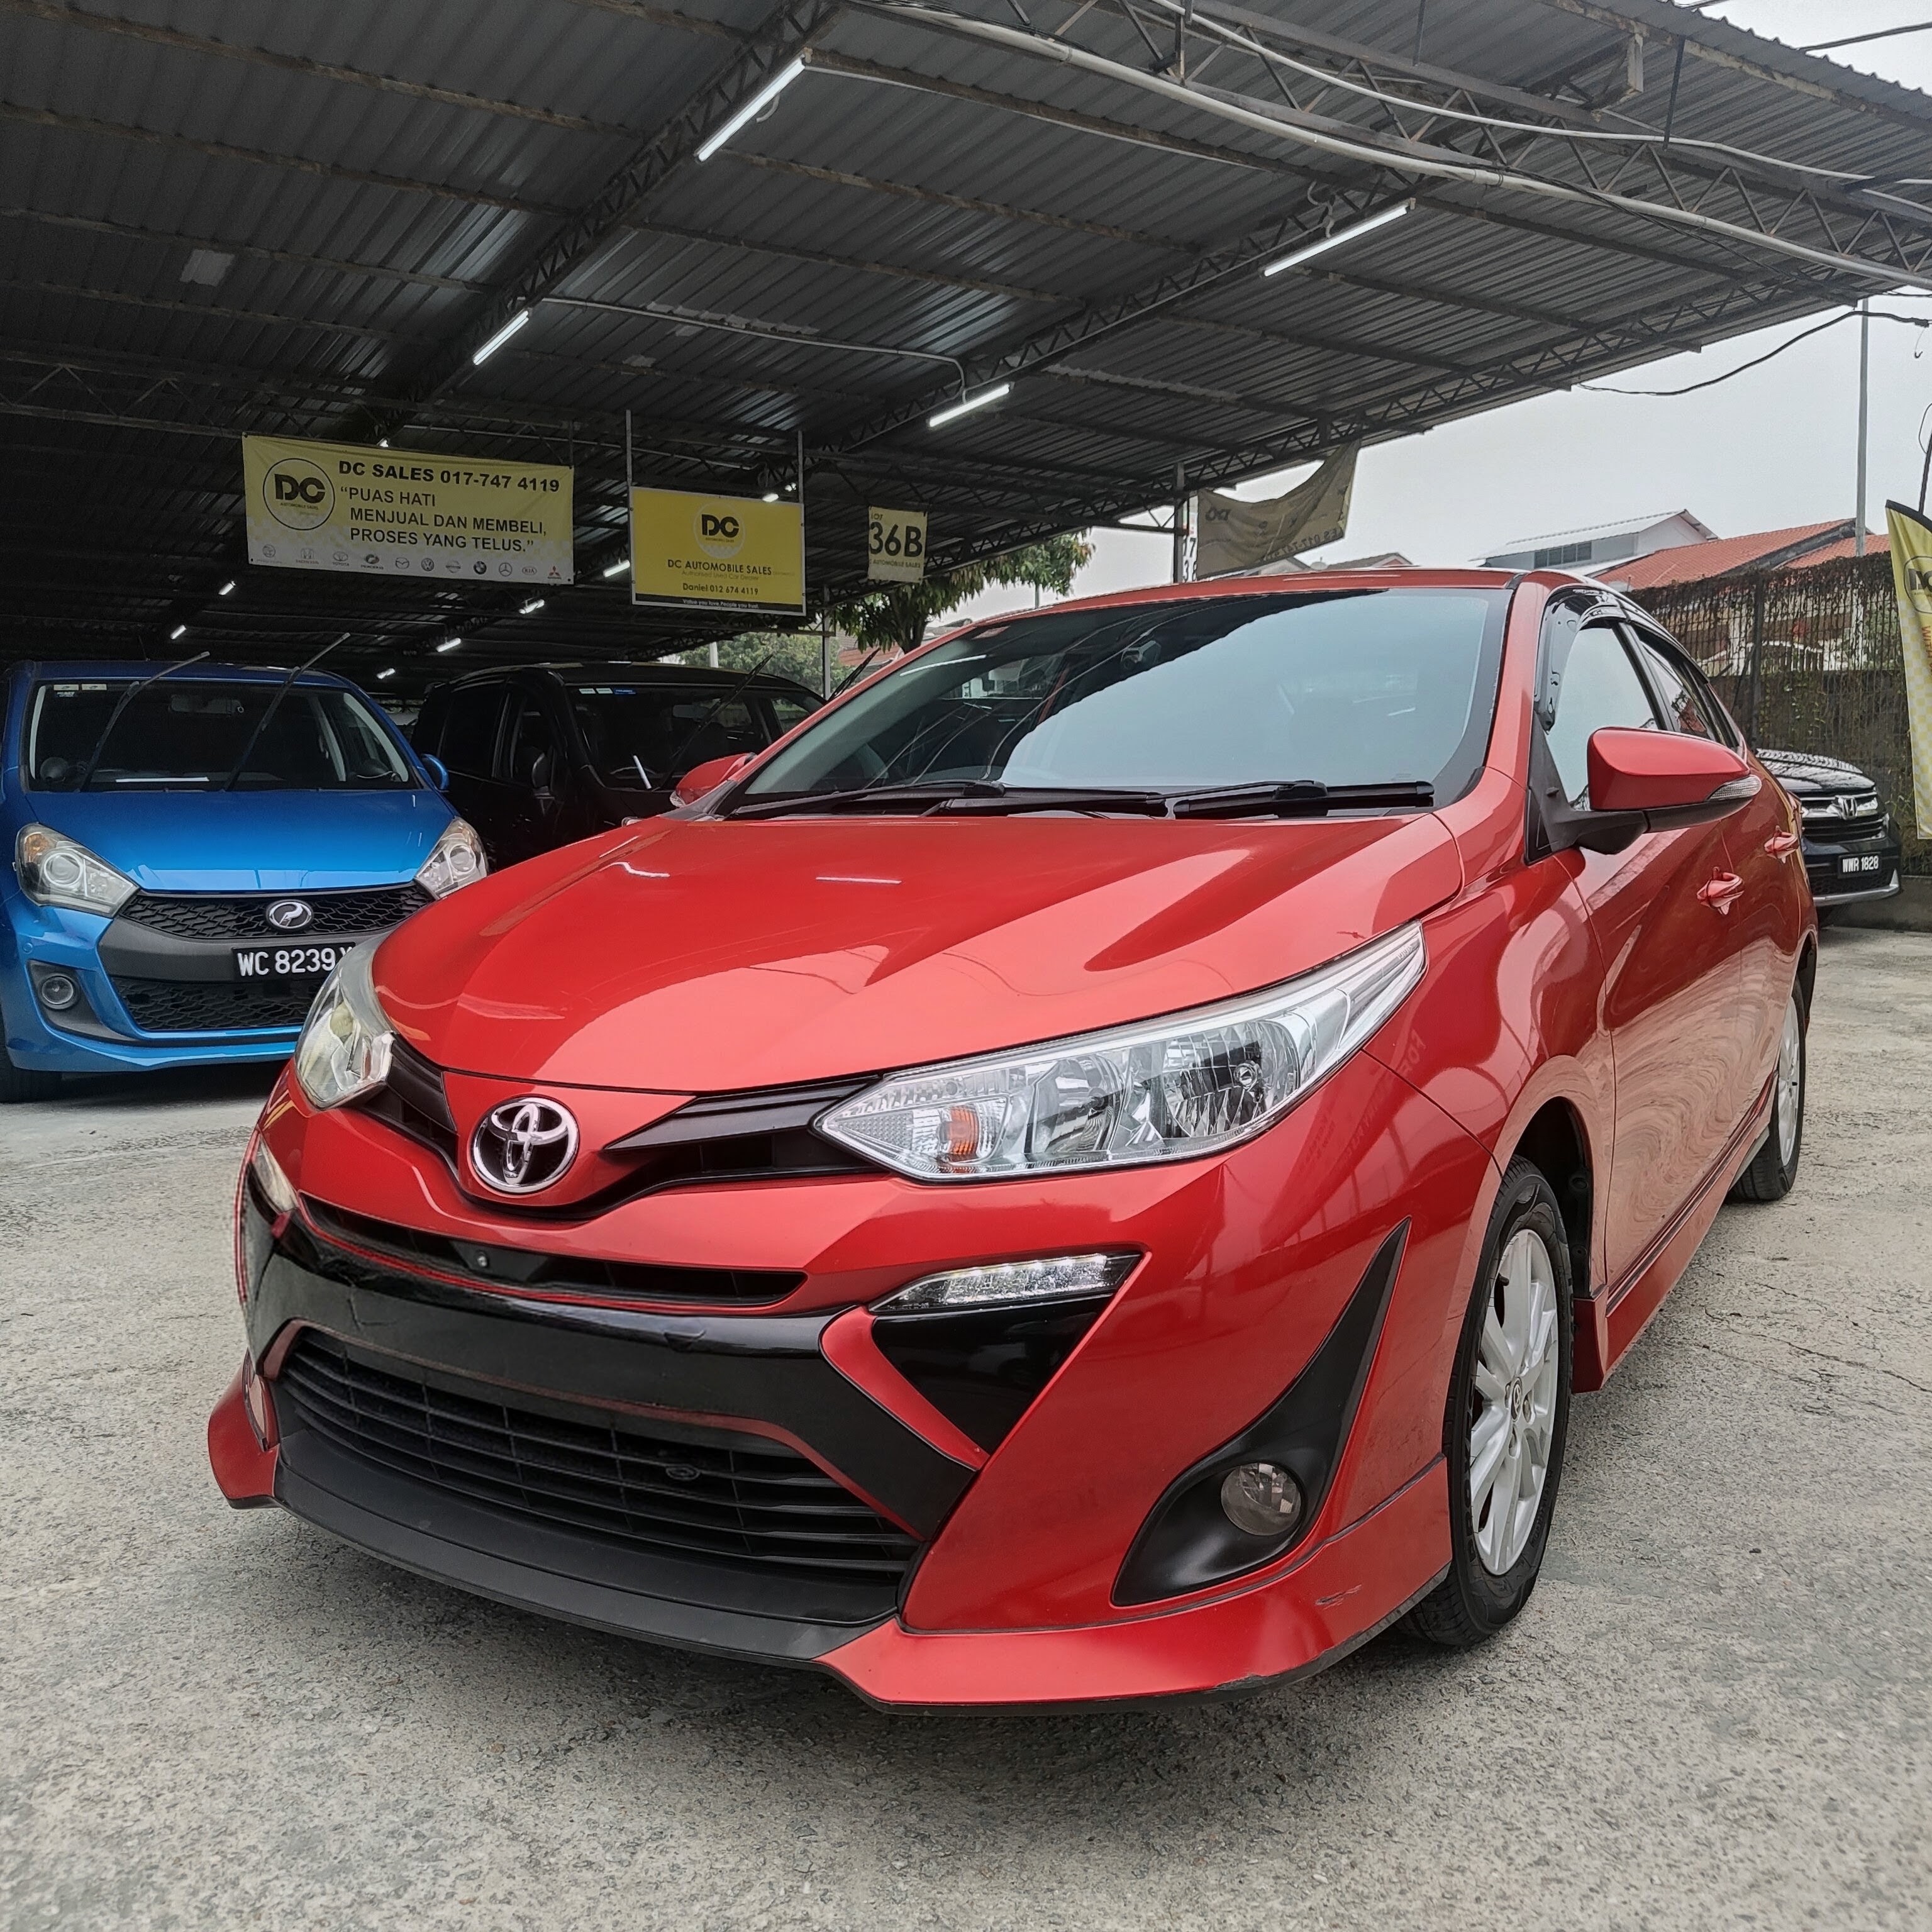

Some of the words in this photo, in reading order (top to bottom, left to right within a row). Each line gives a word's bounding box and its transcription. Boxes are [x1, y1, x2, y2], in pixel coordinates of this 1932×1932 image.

[274, 474, 326, 503] DC
[340, 461, 365, 476] DC
[372, 464, 434, 482] SALES
[440, 470, 511, 489] 017-747
[518, 478, 560, 492] 4119
[341, 487, 394, 503] “PUAS
[399, 492, 436, 506] HATI
[350, 508, 428, 526] MENJUAL
[434, 514, 467, 529] DAN
[472, 518, 547, 536] MEMBELI,
[702, 514, 740, 538] DC
[350, 528, 418, 545] PROSES
[423, 533, 467, 549] YANG
[472, 537, 534, 552] TELUS.”
[870, 521, 923, 557] 36B
[668, 559, 682, 569] DC
[686, 561, 743, 574] AUTOMOBILE
[747, 565, 772, 575] SALES
[683, 583, 708, 592] Daniel
[1842, 857, 1859, 873] WWR
[1860, 855, 1879, 871] 1828
[237, 952, 269, 976] WC
[275, 948, 336, 974] 8239
